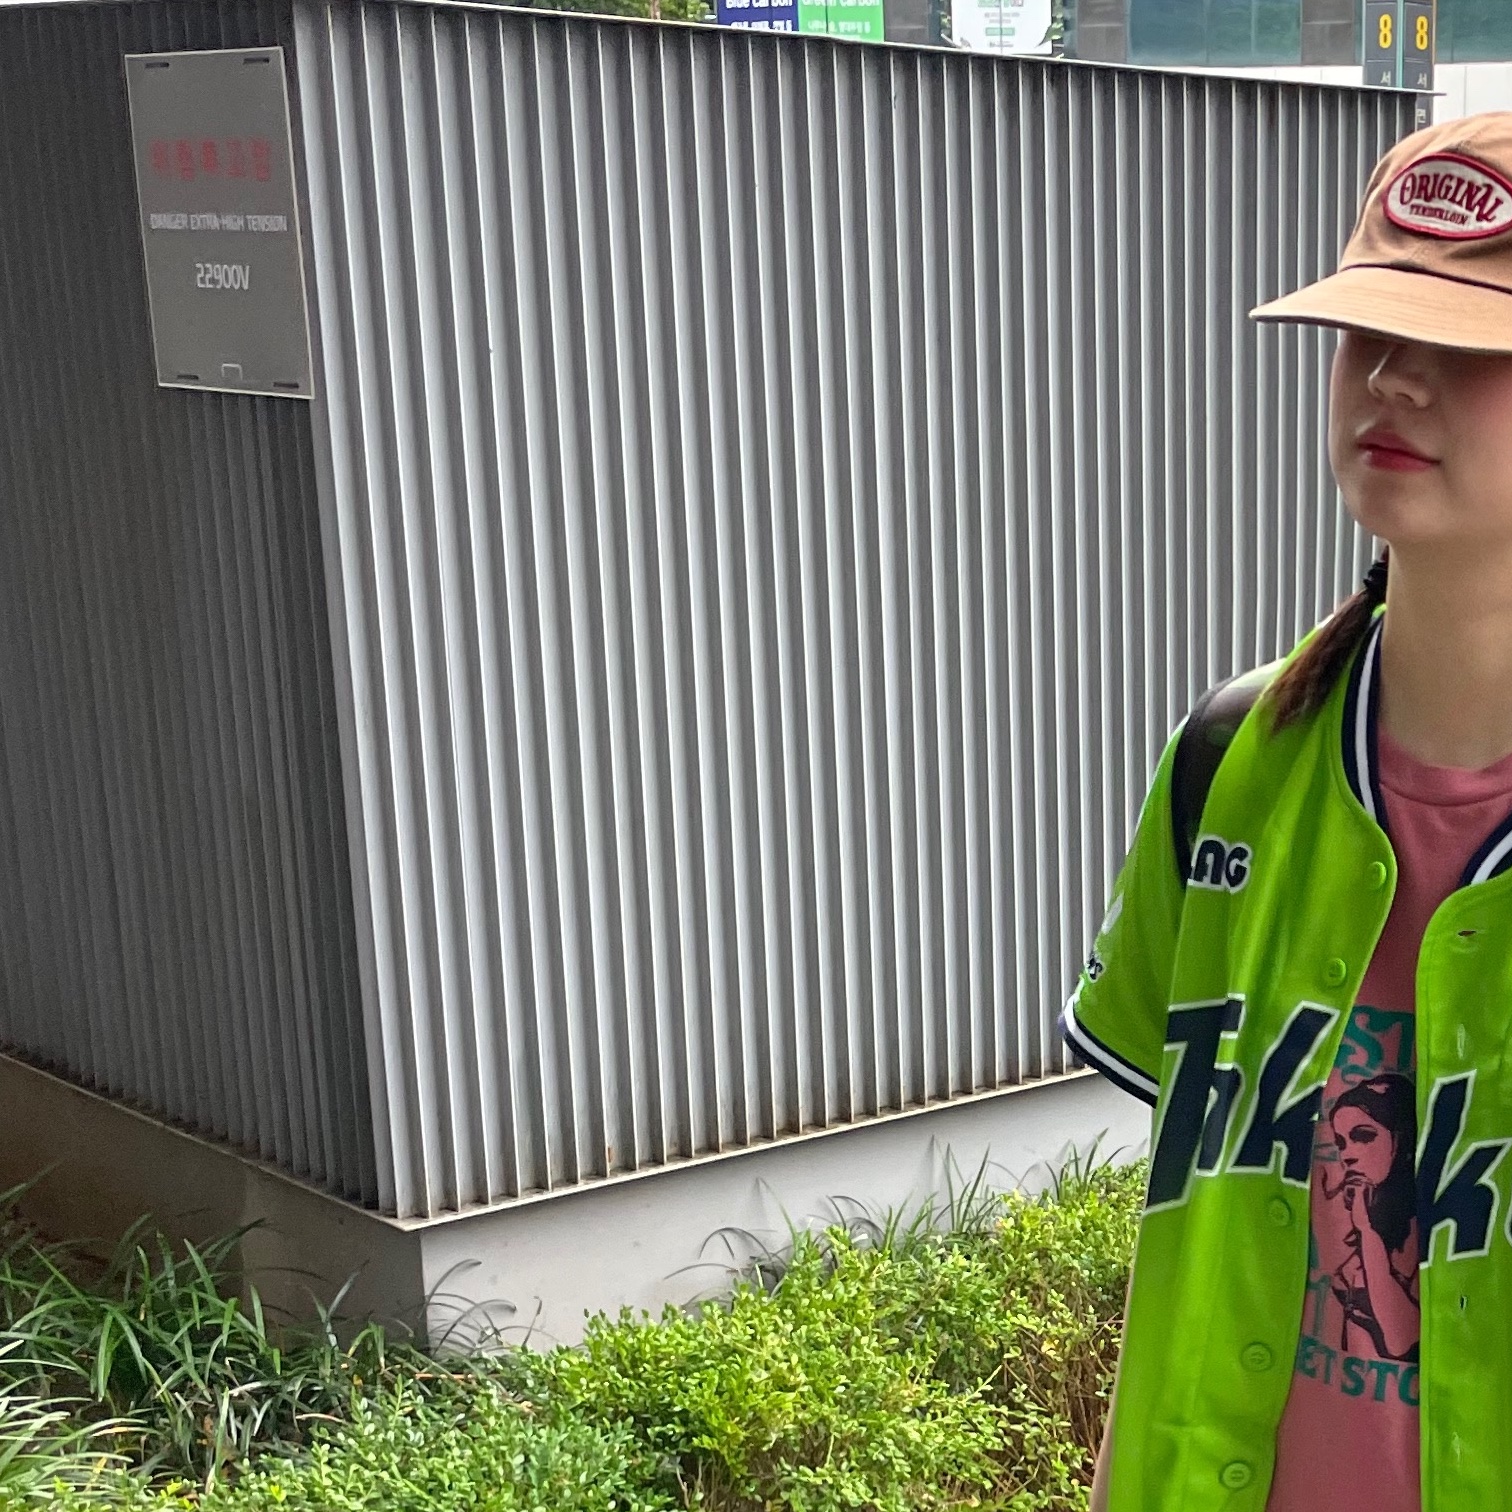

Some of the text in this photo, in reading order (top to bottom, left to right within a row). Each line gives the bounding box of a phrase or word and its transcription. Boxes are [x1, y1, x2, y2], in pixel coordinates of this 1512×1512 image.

[1379, 13, 1392, 49] 8
[1416, 15, 1428, 51] 8
[1399, 172, 1504, 223] ORIGINAL
[195, 262, 250, 290] 22900V
